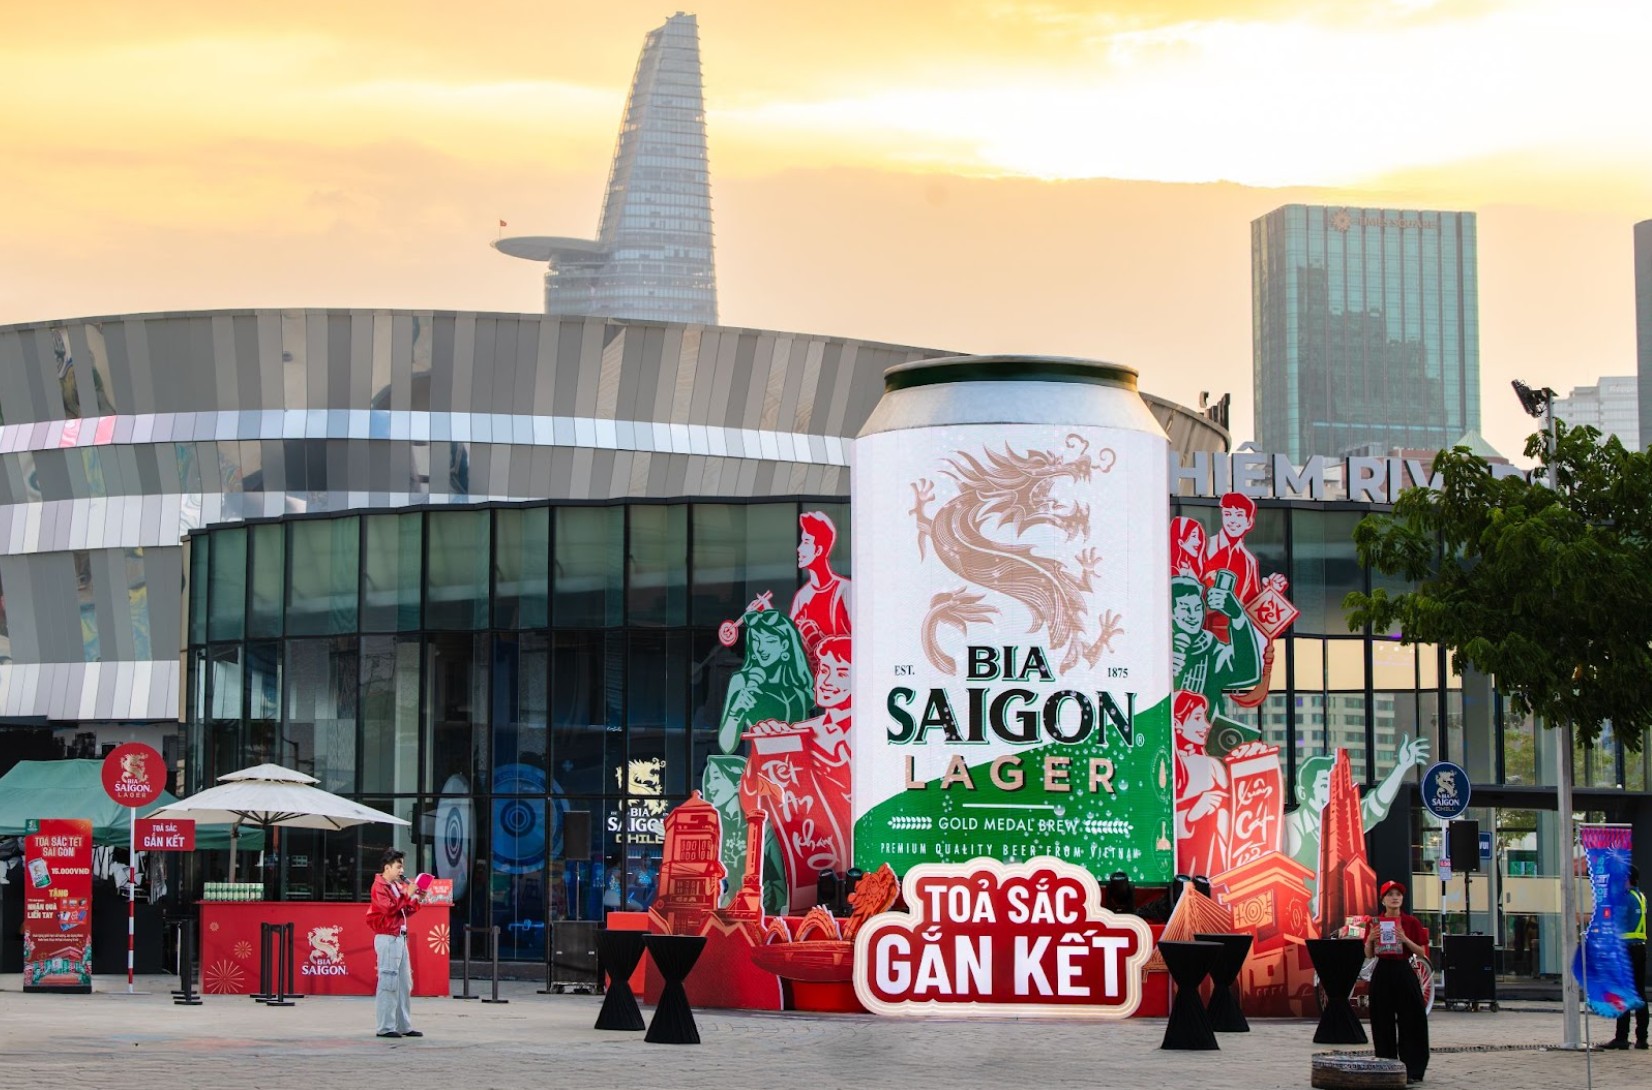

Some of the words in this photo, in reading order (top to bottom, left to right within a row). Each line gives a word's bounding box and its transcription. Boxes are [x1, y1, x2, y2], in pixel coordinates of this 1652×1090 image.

[1169, 441, 1325, 499] HIÊM
[894, 665, 915, 676] EST.
[966, 646, 1056, 682] BIA
[1107, 667, 1128, 678] 1875
[886, 686, 1137, 748] SAIGON
[905, 754, 1117, 794] LAGER
[115, 783, 151, 792] SAIGON
[1432, 798, 1460, 807] SAIGON
[630, 807, 650, 817] BIA
[608, 817, 665, 832] SIGO
[939, 817, 978, 830] GOLD
[984, 818, 1033, 831] MEDAL
[1039, 819, 1079, 832] BREW
[166, 833, 185, 847] KẾT
[880, 843, 926, 854] PREMIUM
[936, 843, 993, 855] QUALITY
[1002, 844, 1036, 856] BEER
[1046, 845, 1081, 857] FROM
[1090, 845, 1140, 860] VIETNAM
[924, 878, 996, 923] TOẢ
[1007, 877, 1078, 924] SẮC
[875, 925, 993, 995] GẮN
[1014, 929, 1129, 997] KẾT
[302, 965, 346, 975] SAIGON
